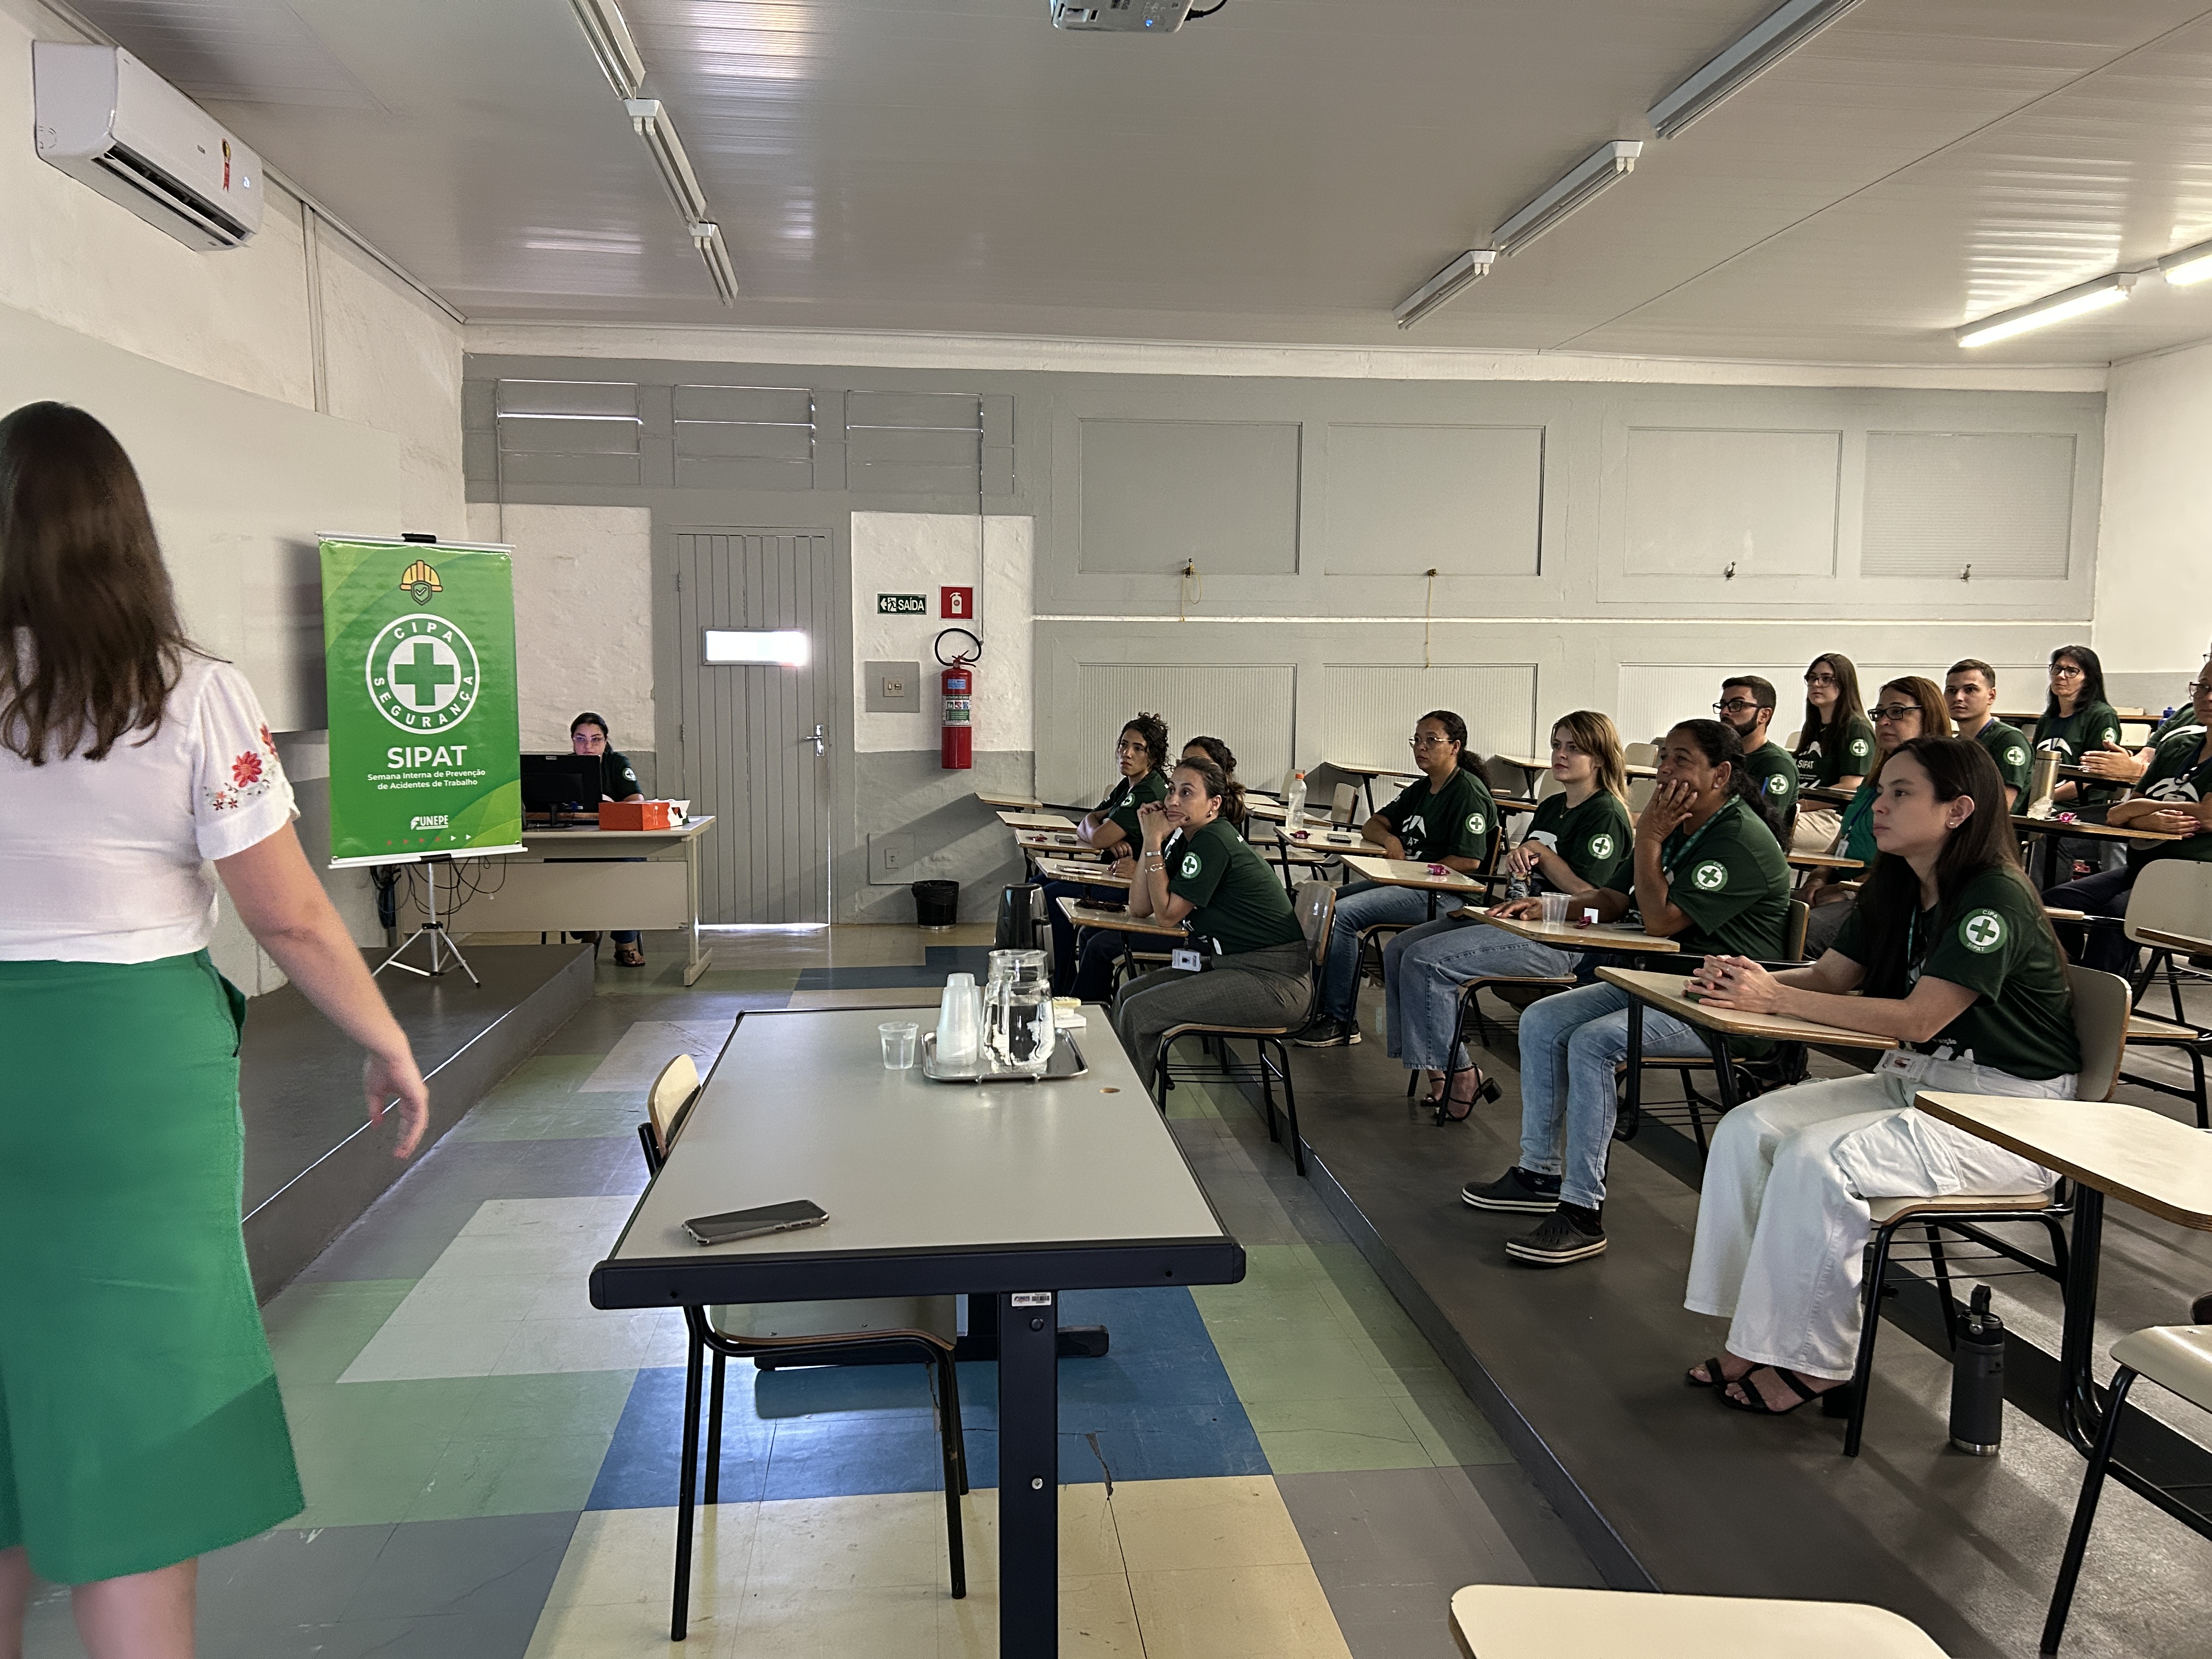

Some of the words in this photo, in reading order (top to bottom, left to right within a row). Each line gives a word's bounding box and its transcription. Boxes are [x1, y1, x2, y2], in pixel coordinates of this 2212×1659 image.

[898, 597, 924, 611] SAÍDA
[394, 622, 453, 642] CIPA
[374, 676, 473, 727] SEGURANÇA
[387, 746, 467, 769] SIPAT
[445, 769, 486, 777] Prevenção
[390, 781, 430, 789] Acidentes
[1982, 910, 1997, 919] CIPA
[1967, 943, 1985, 951] SIPAT
